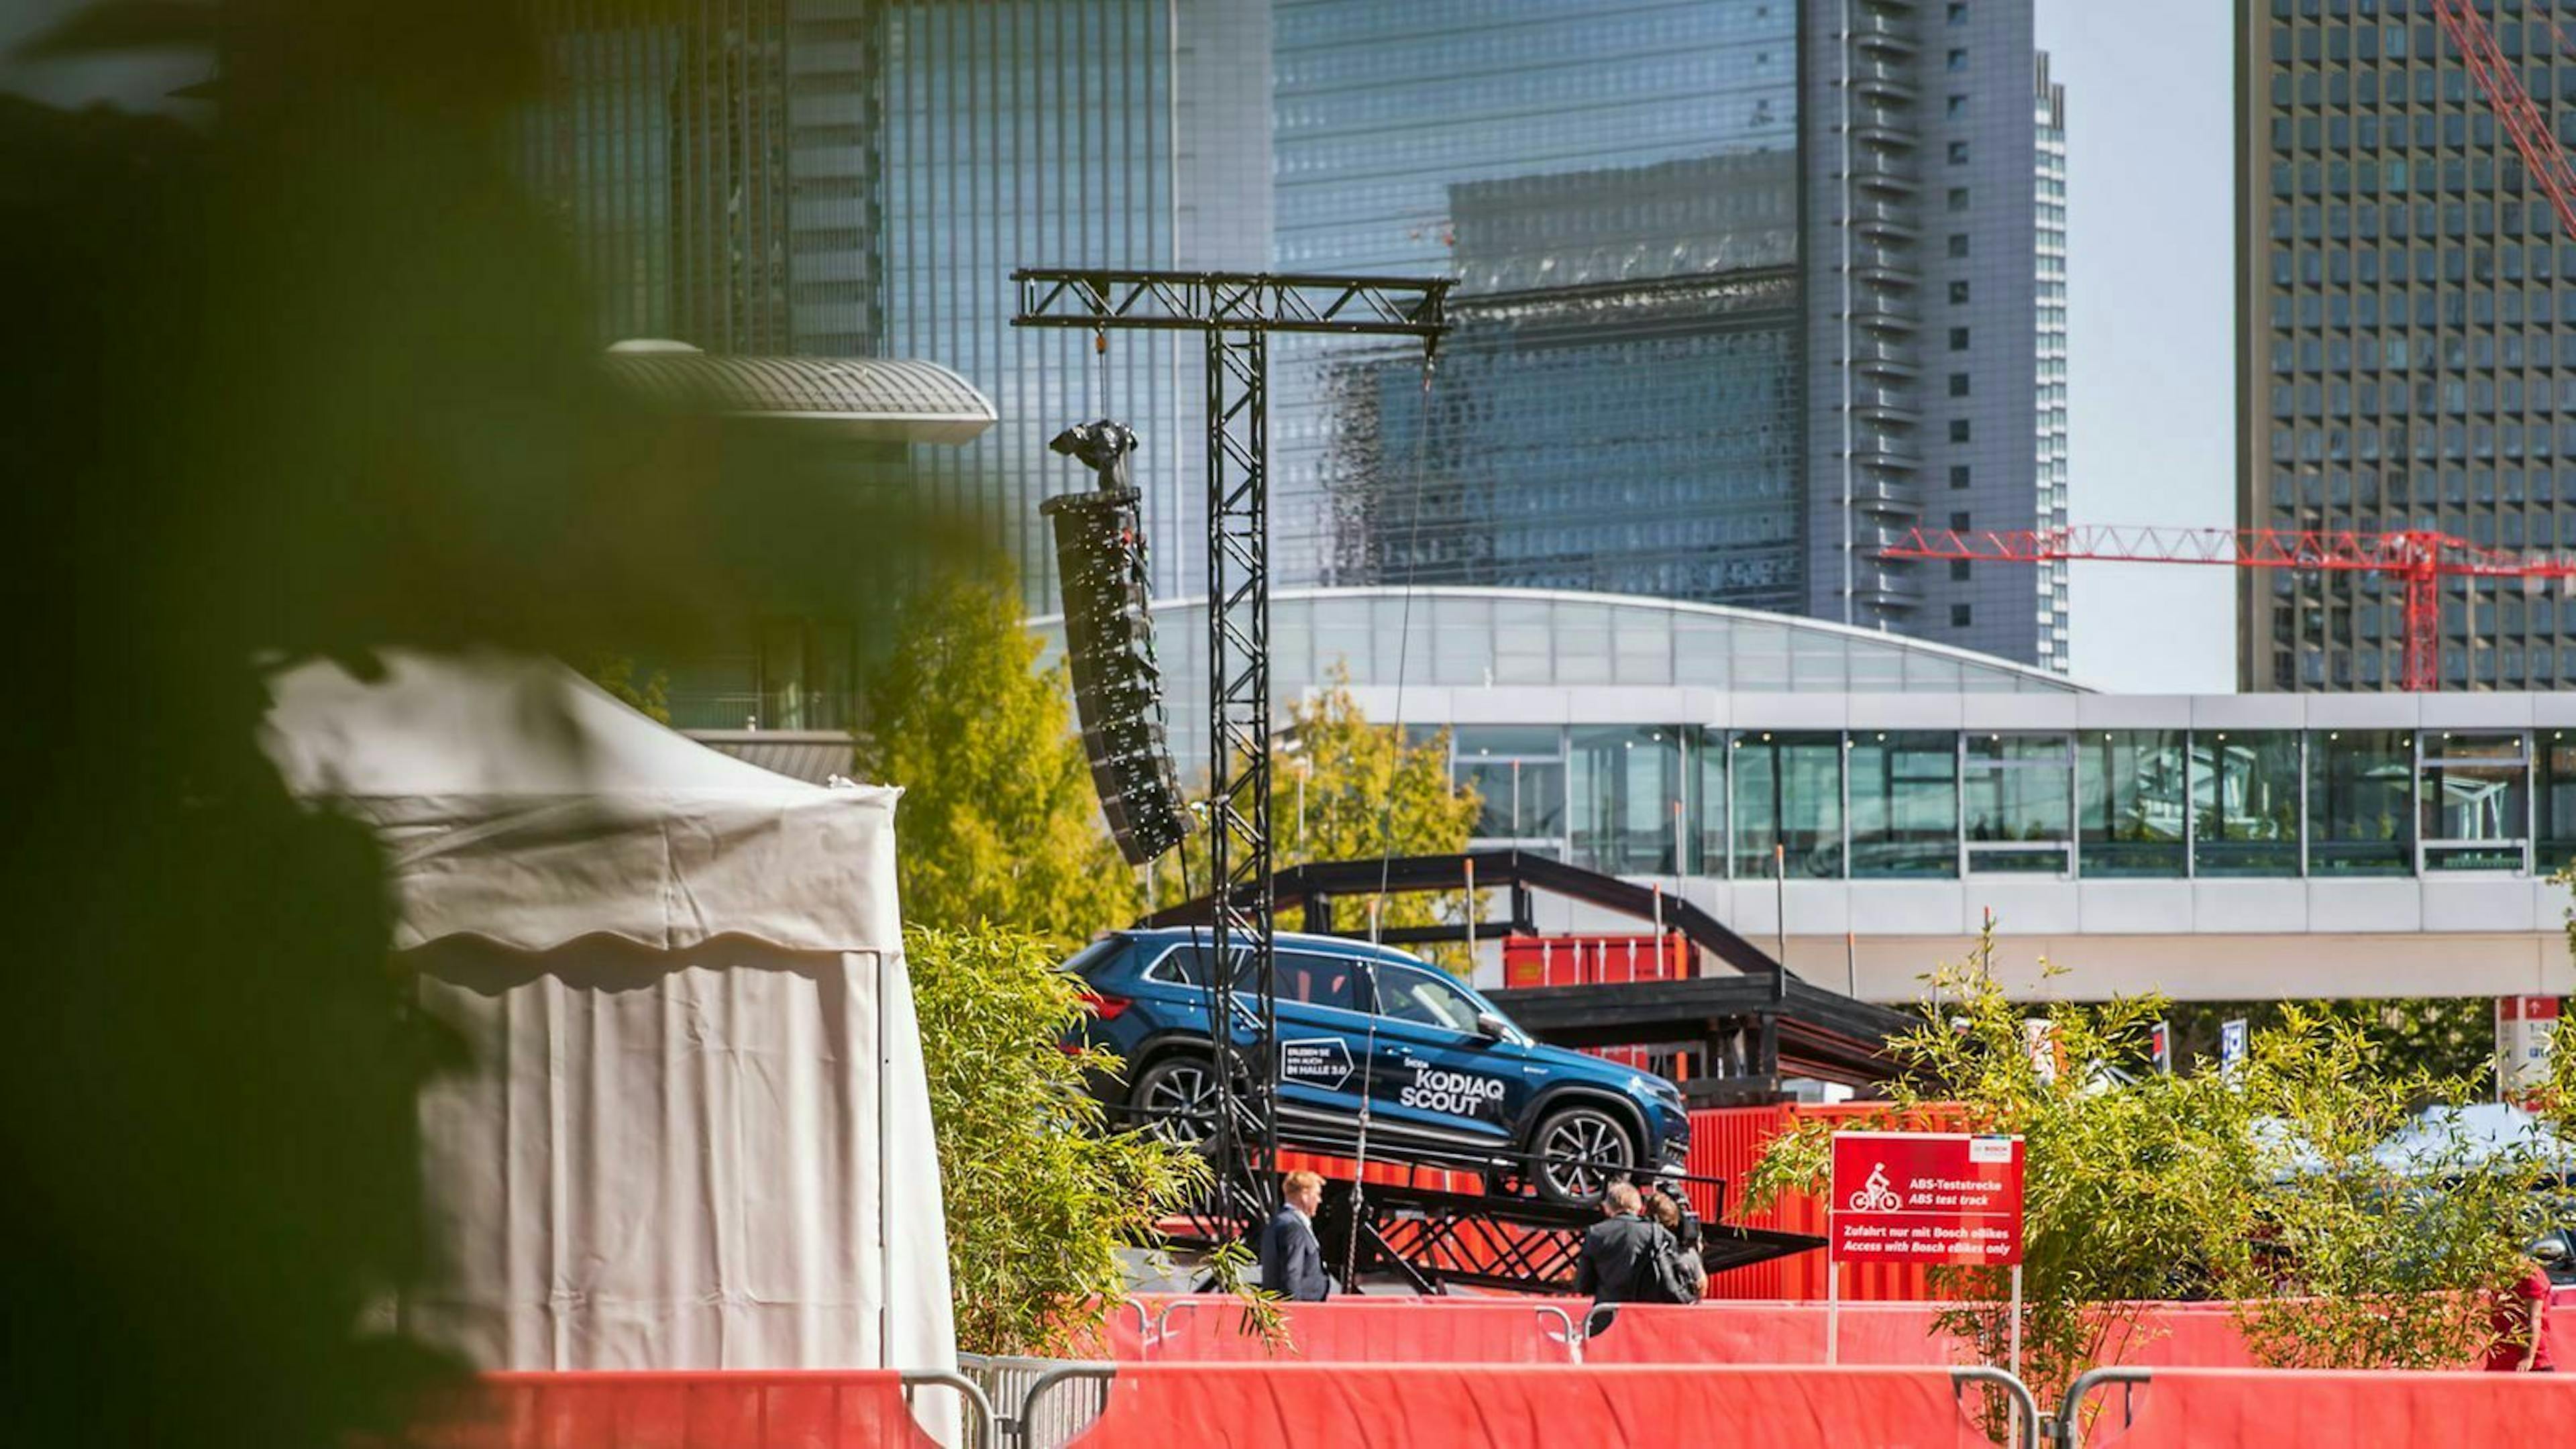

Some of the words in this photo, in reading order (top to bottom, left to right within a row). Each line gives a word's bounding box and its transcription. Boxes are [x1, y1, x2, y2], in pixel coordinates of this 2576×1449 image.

[1299, 1065, 1329, 1075] HALLE
[1415, 1068, 1505, 1101] KODIAQ
[1399, 1085, 1483, 1116] SCOUT
[1909, 1179, 2002, 1191] ABS-Teststrecke
[1909, 1193, 1933, 1205] ABS
[1935, 1195, 1957, 1205] test
[1960, 1195, 1988, 1206] track
[1843, 1224, 1887, 1237] Zufahrt
[1888, 1227, 1909, 1238] nur
[1911, 1226, 1931, 1238] mit
[1933, 1227, 1968, 1239] Bosch
[1970, 1228, 2010, 1240] eBikes
[1843, 1240, 1882, 1252] Access
[1884, 1242, 1909, 1252] with
[1911, 1242, 1945, 1253] Bosch
[1947, 1242, 1984, 1254] eBikes
[1986, 1243, 2011, 1256] only
